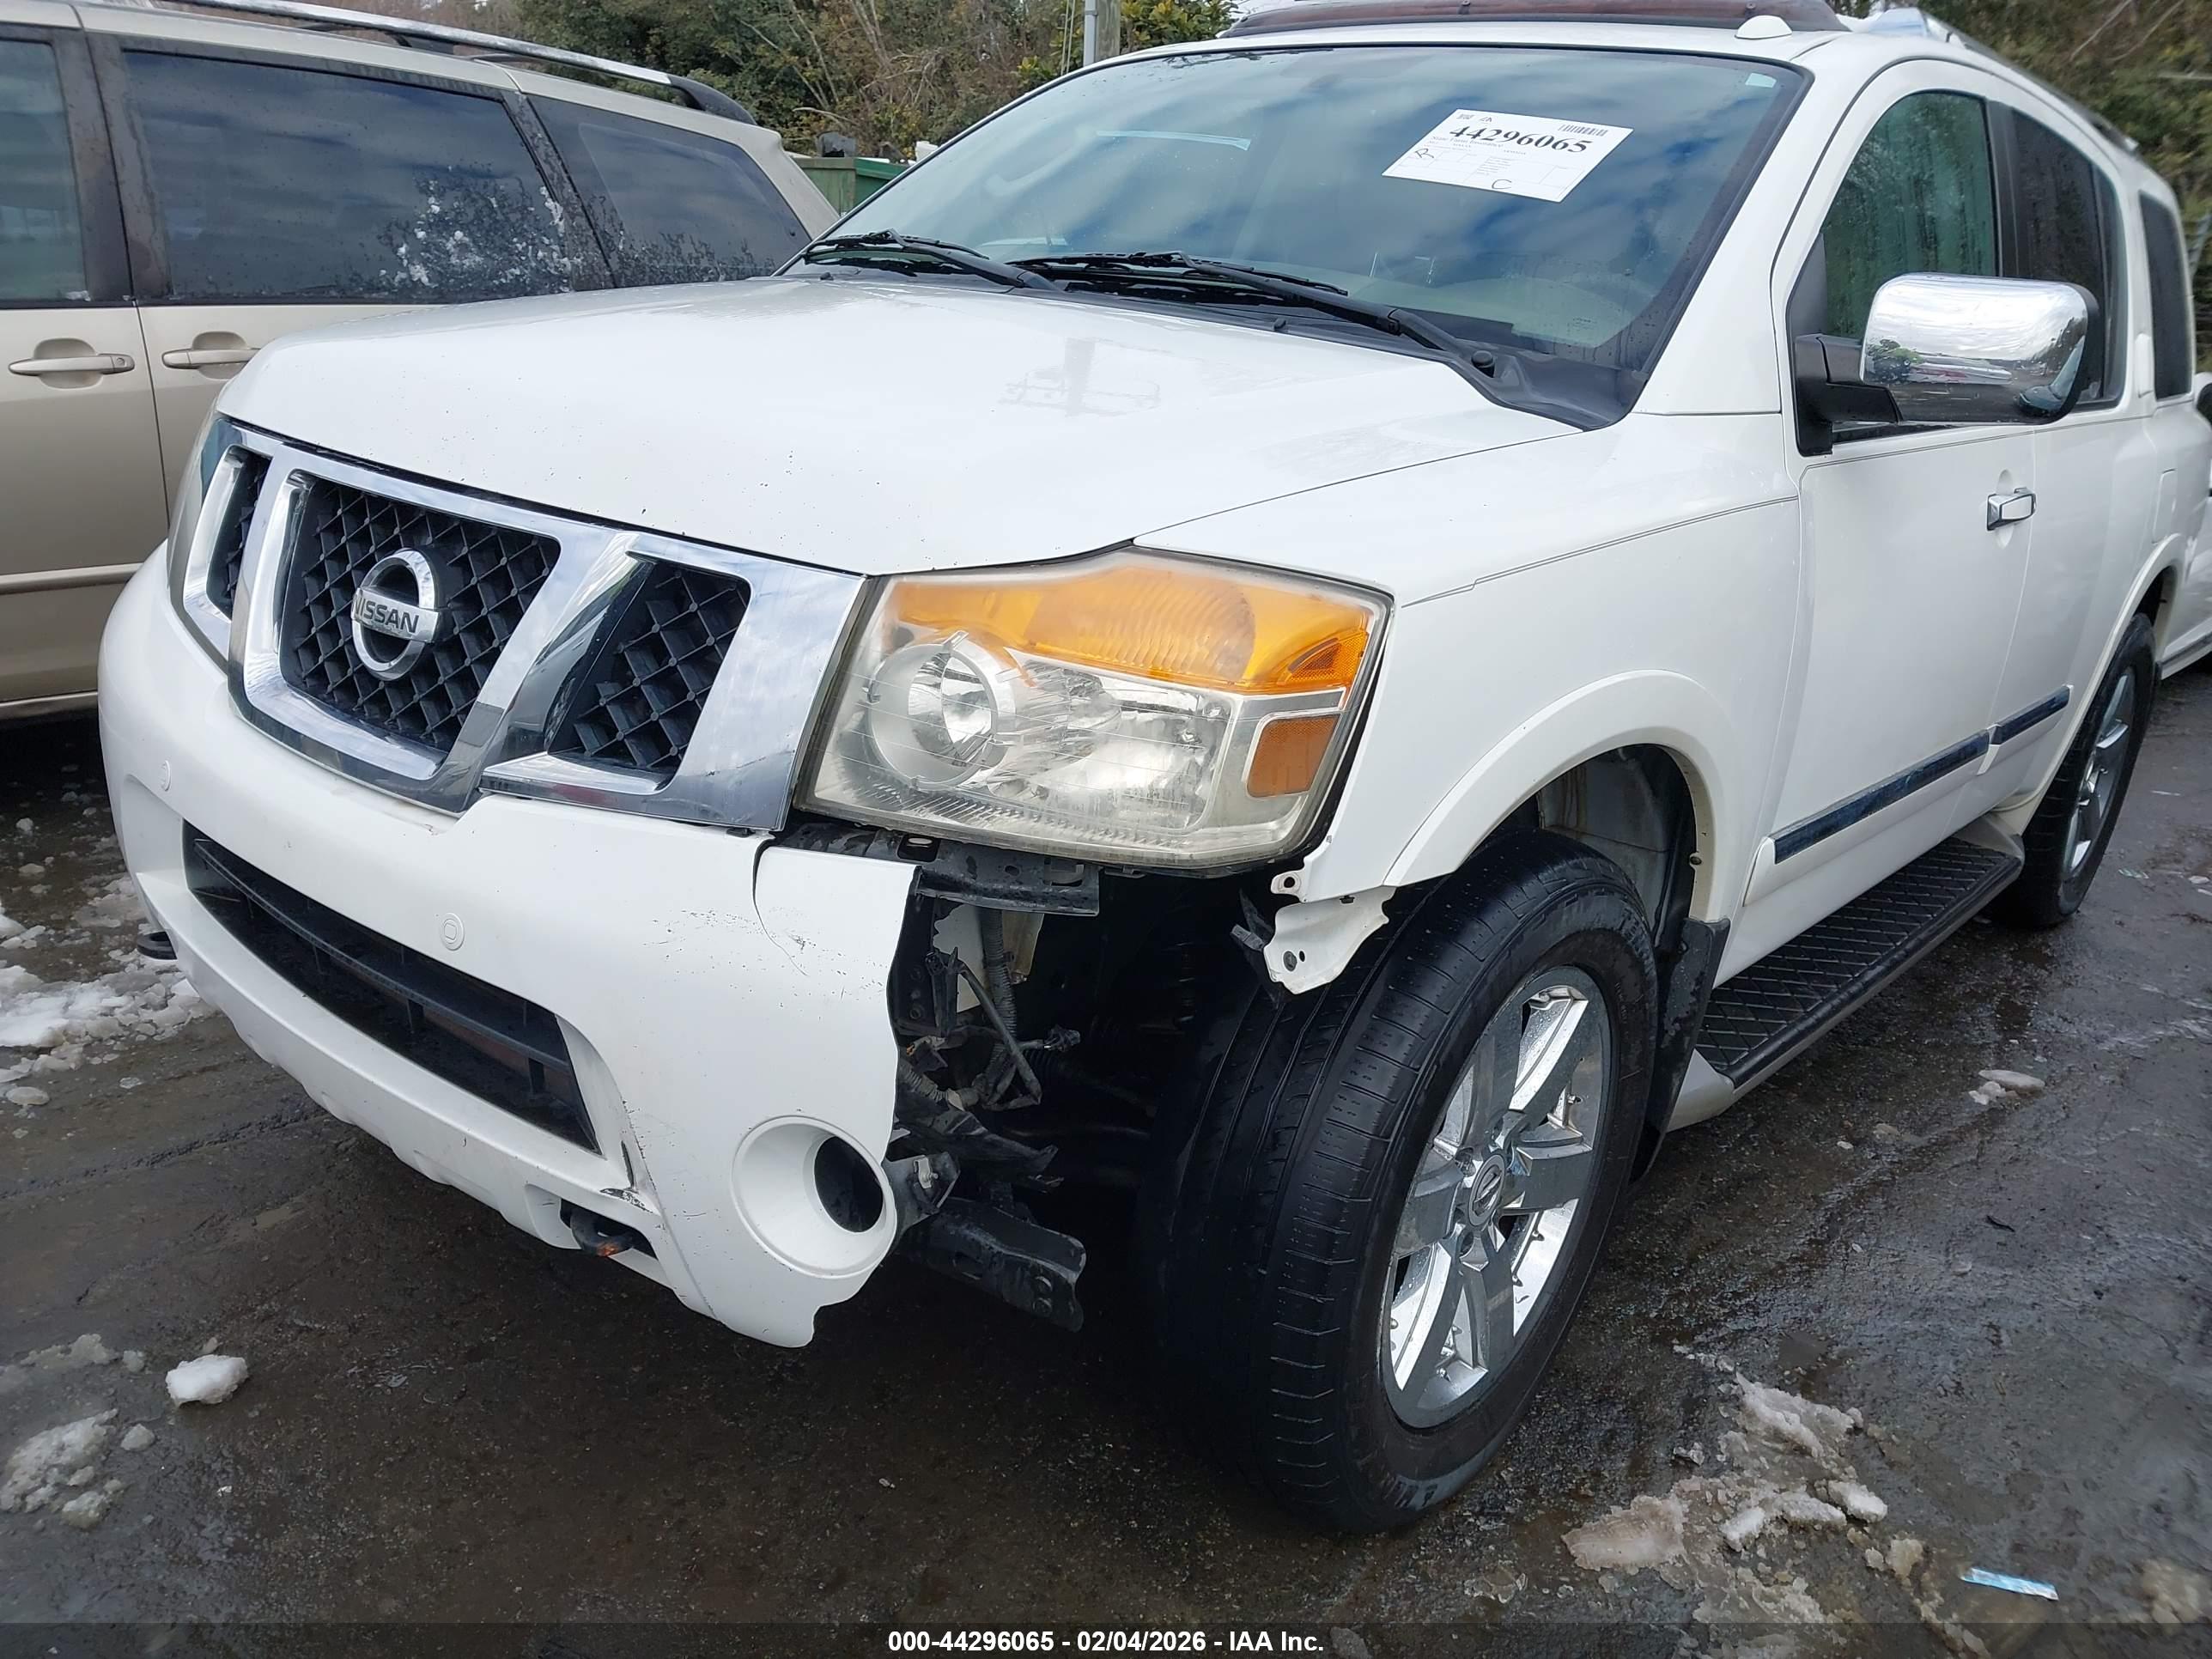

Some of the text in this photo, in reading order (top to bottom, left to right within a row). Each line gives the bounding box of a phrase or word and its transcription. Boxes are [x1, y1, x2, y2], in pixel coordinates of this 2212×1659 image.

[1449, 125, 1593, 154] 44296065
[1415, 148, 1434, 159] R
[1492, 179, 1512, 190] C
[354, 596, 419, 634] NISSAN
